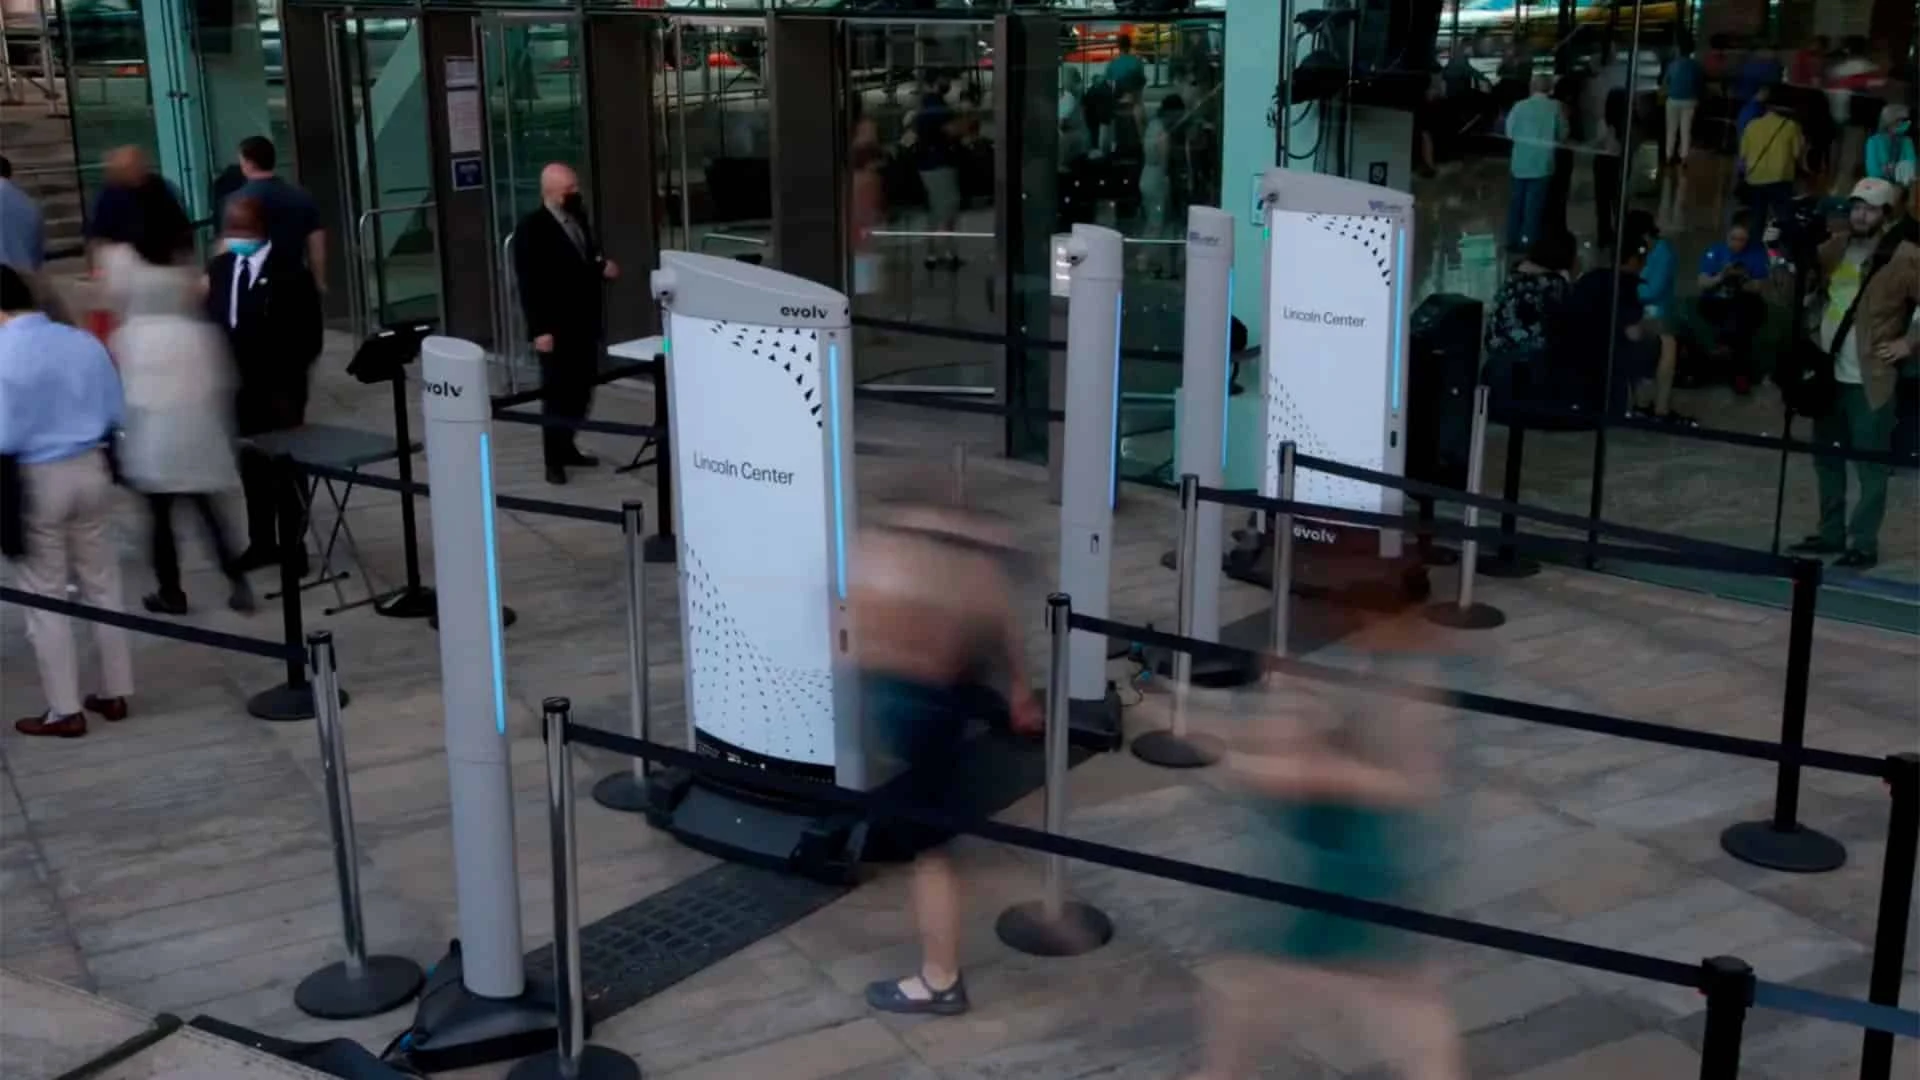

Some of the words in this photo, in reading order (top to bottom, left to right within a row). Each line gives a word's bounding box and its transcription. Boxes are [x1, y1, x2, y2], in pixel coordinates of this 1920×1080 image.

[780, 304, 829, 319] evolv
[1282, 304, 1321, 323] Lincoln
[1323, 311, 1366, 328] Center
[693, 449, 738, 478] Lincoln
[741, 461, 794, 486] Center
